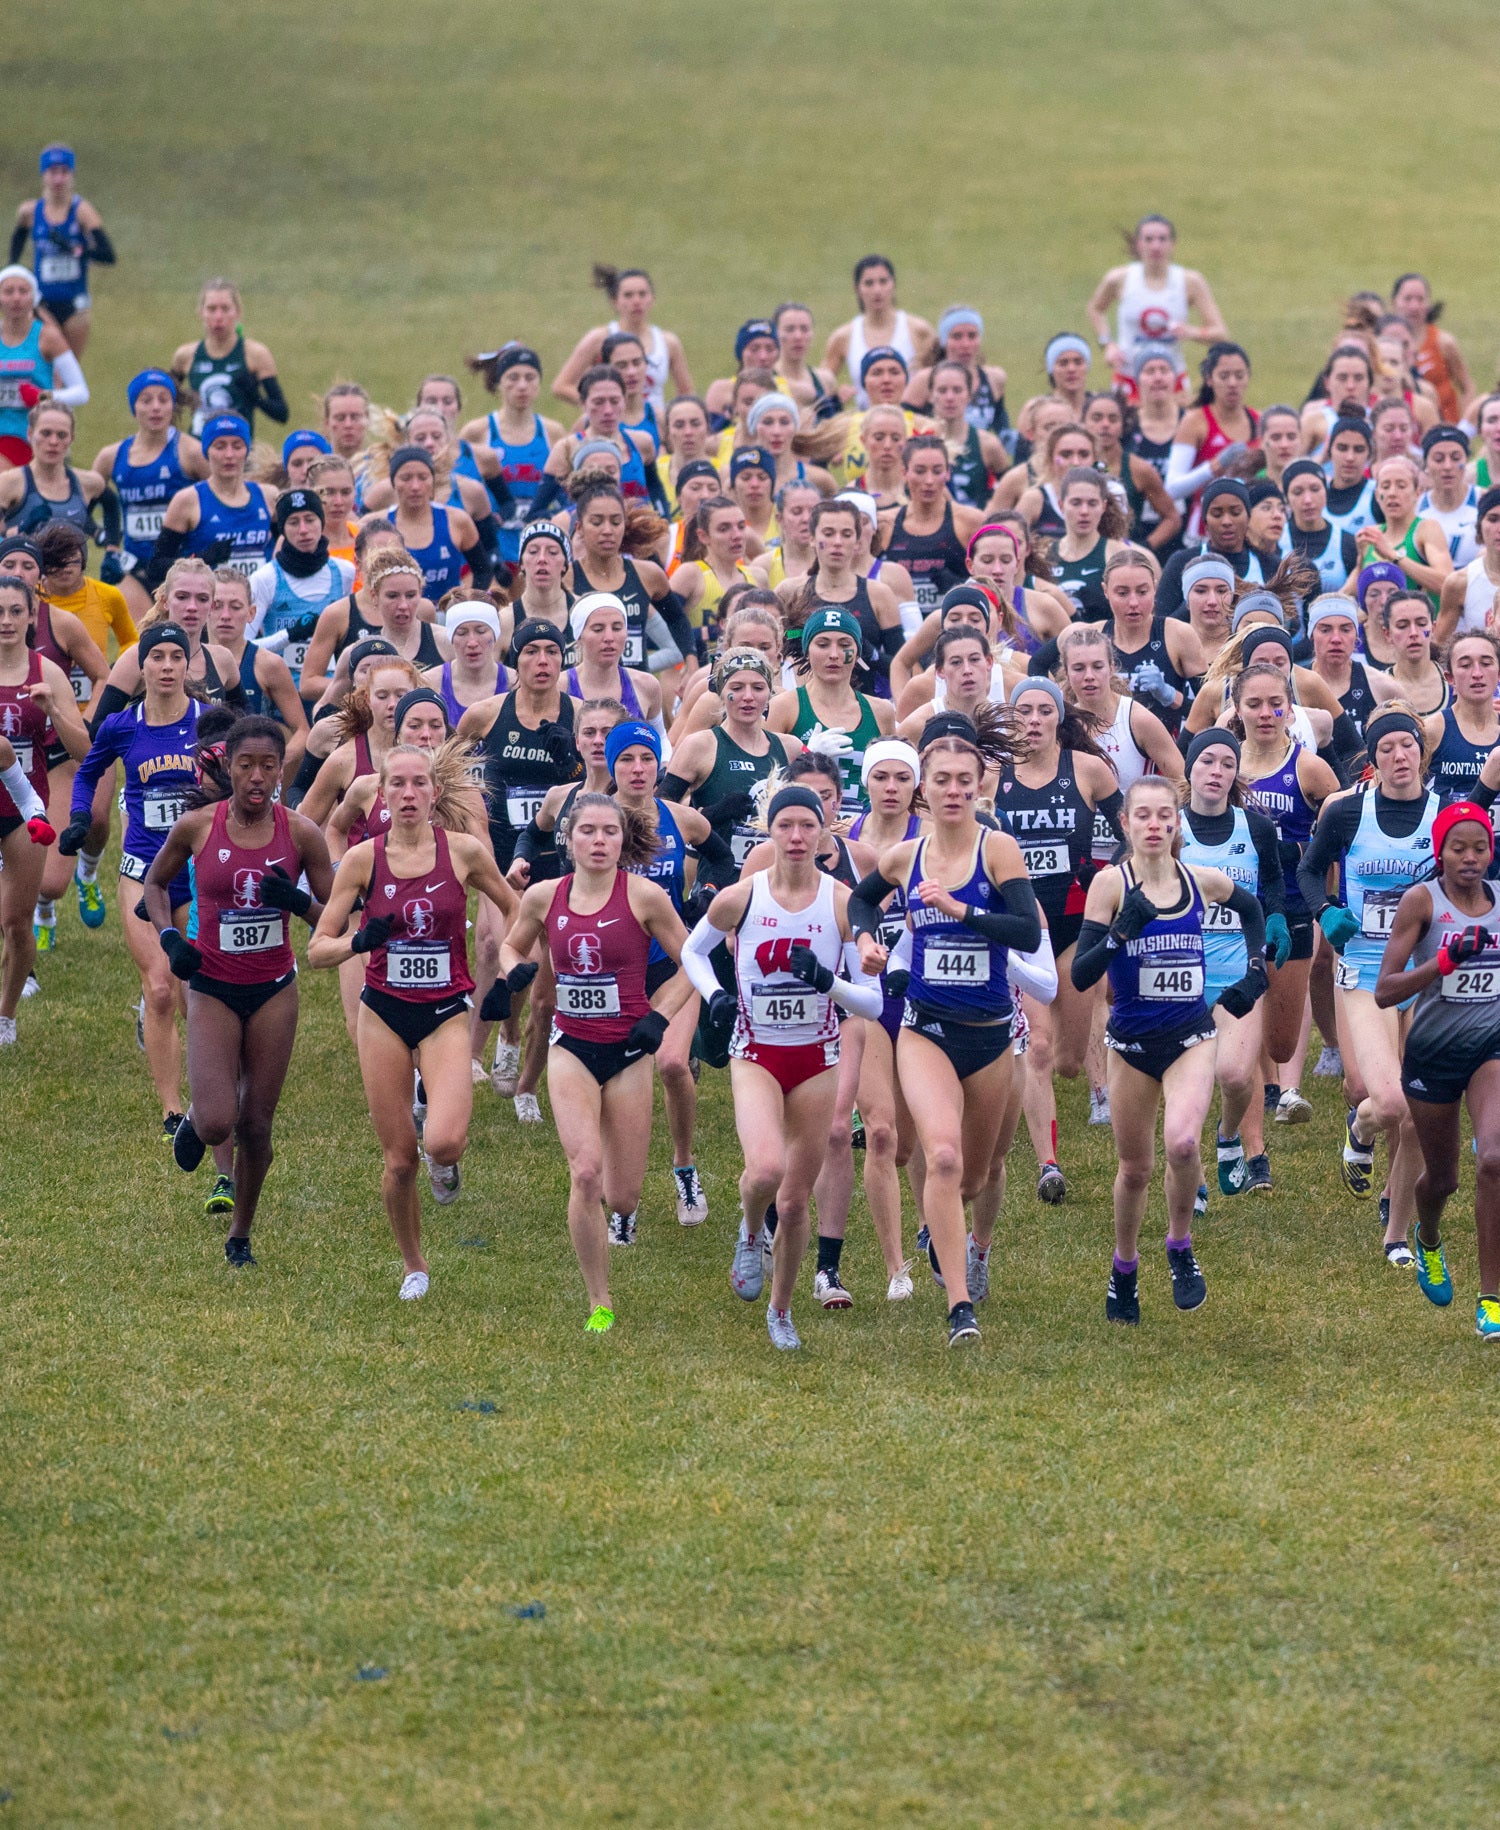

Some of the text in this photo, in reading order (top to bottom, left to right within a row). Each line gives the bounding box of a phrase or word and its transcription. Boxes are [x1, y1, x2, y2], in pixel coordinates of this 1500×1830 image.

[121, 484, 166, 499] TULSA
[917, 588, 937, 604] 85
[823, 610, 841, 626] E
[502, 745, 553, 763] COLORA
[1441, 761, 1484, 775] MONTAN
[1246, 791, 1294, 814] INGTON
[1093, 820, 1112, 838] 58
[632, 860, 675, 877] LSA
[1025, 850, 1057, 871] 423
[1357, 858, 1428, 876] COLUMBI
[1217, 866, 1253, 884] MBIA
[911, 908, 960, 926] WASHIN
[1377, 908, 1397, 929] 17
[232, 924, 270, 947] 387
[400, 957, 438, 979] 386
[936, 953, 976, 976] 444
[1153, 970, 1193, 993] 446
[1456, 971, 1494, 994] 242
[568, 988, 606, 1010] 383
[765, 999, 805, 1021] 454
